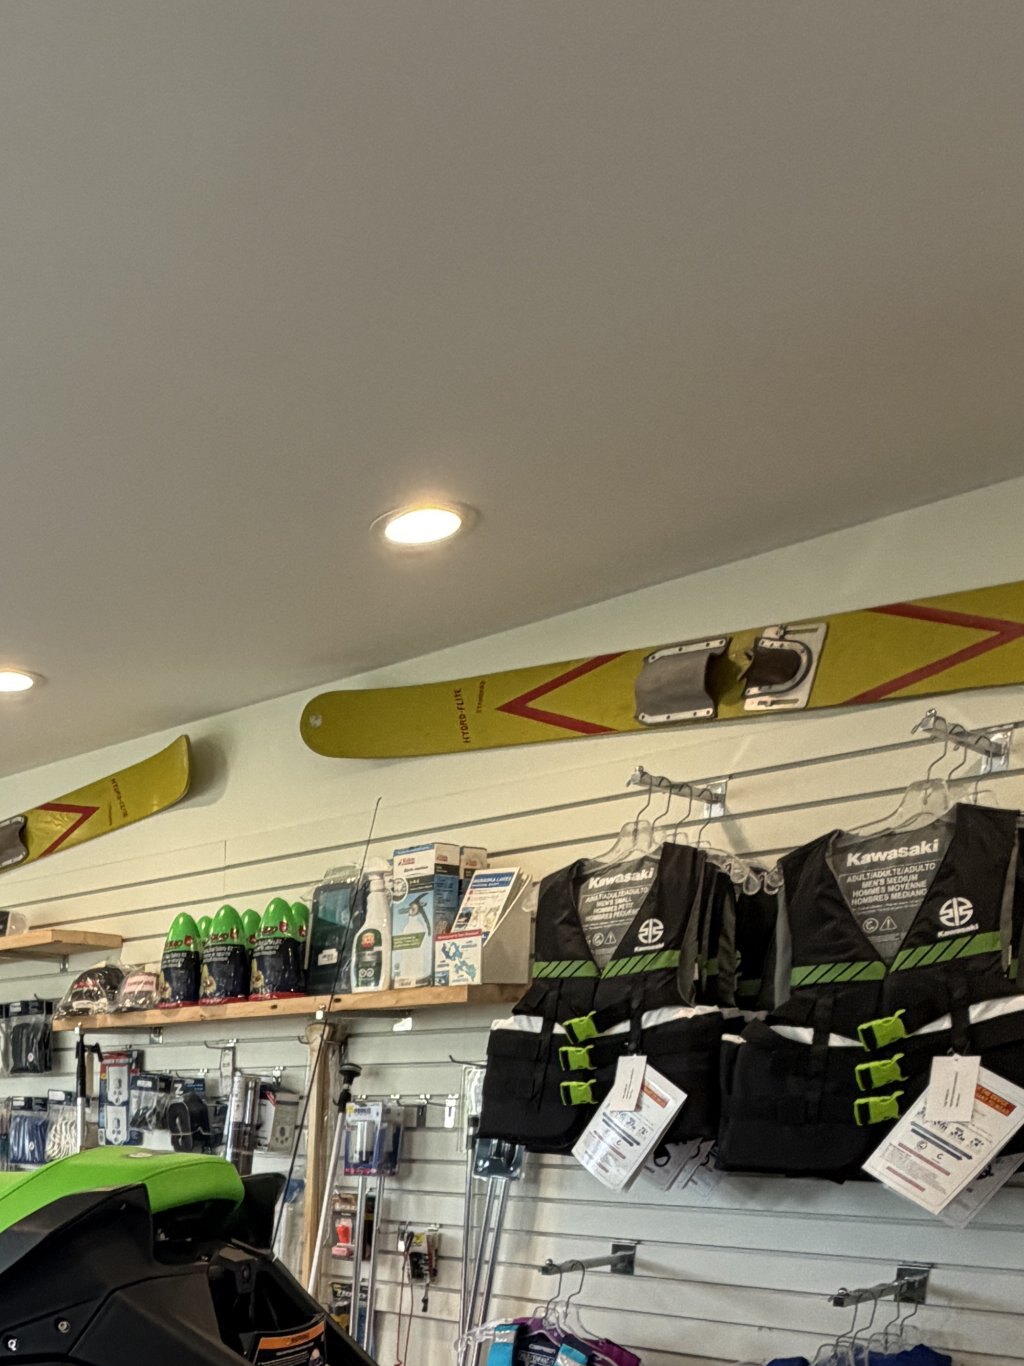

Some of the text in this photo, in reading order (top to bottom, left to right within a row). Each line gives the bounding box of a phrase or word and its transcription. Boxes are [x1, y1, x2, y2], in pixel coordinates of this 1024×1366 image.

[454, 688, 471, 743] HYDRO-FLITE
[846, 838, 939, 867] Kawasaki
[588, 867, 655, 889] Kawasaki
[852, 880, 927, 898] HOMMES MOYENNE
[887, 874, 919, 884] MEDIUM
